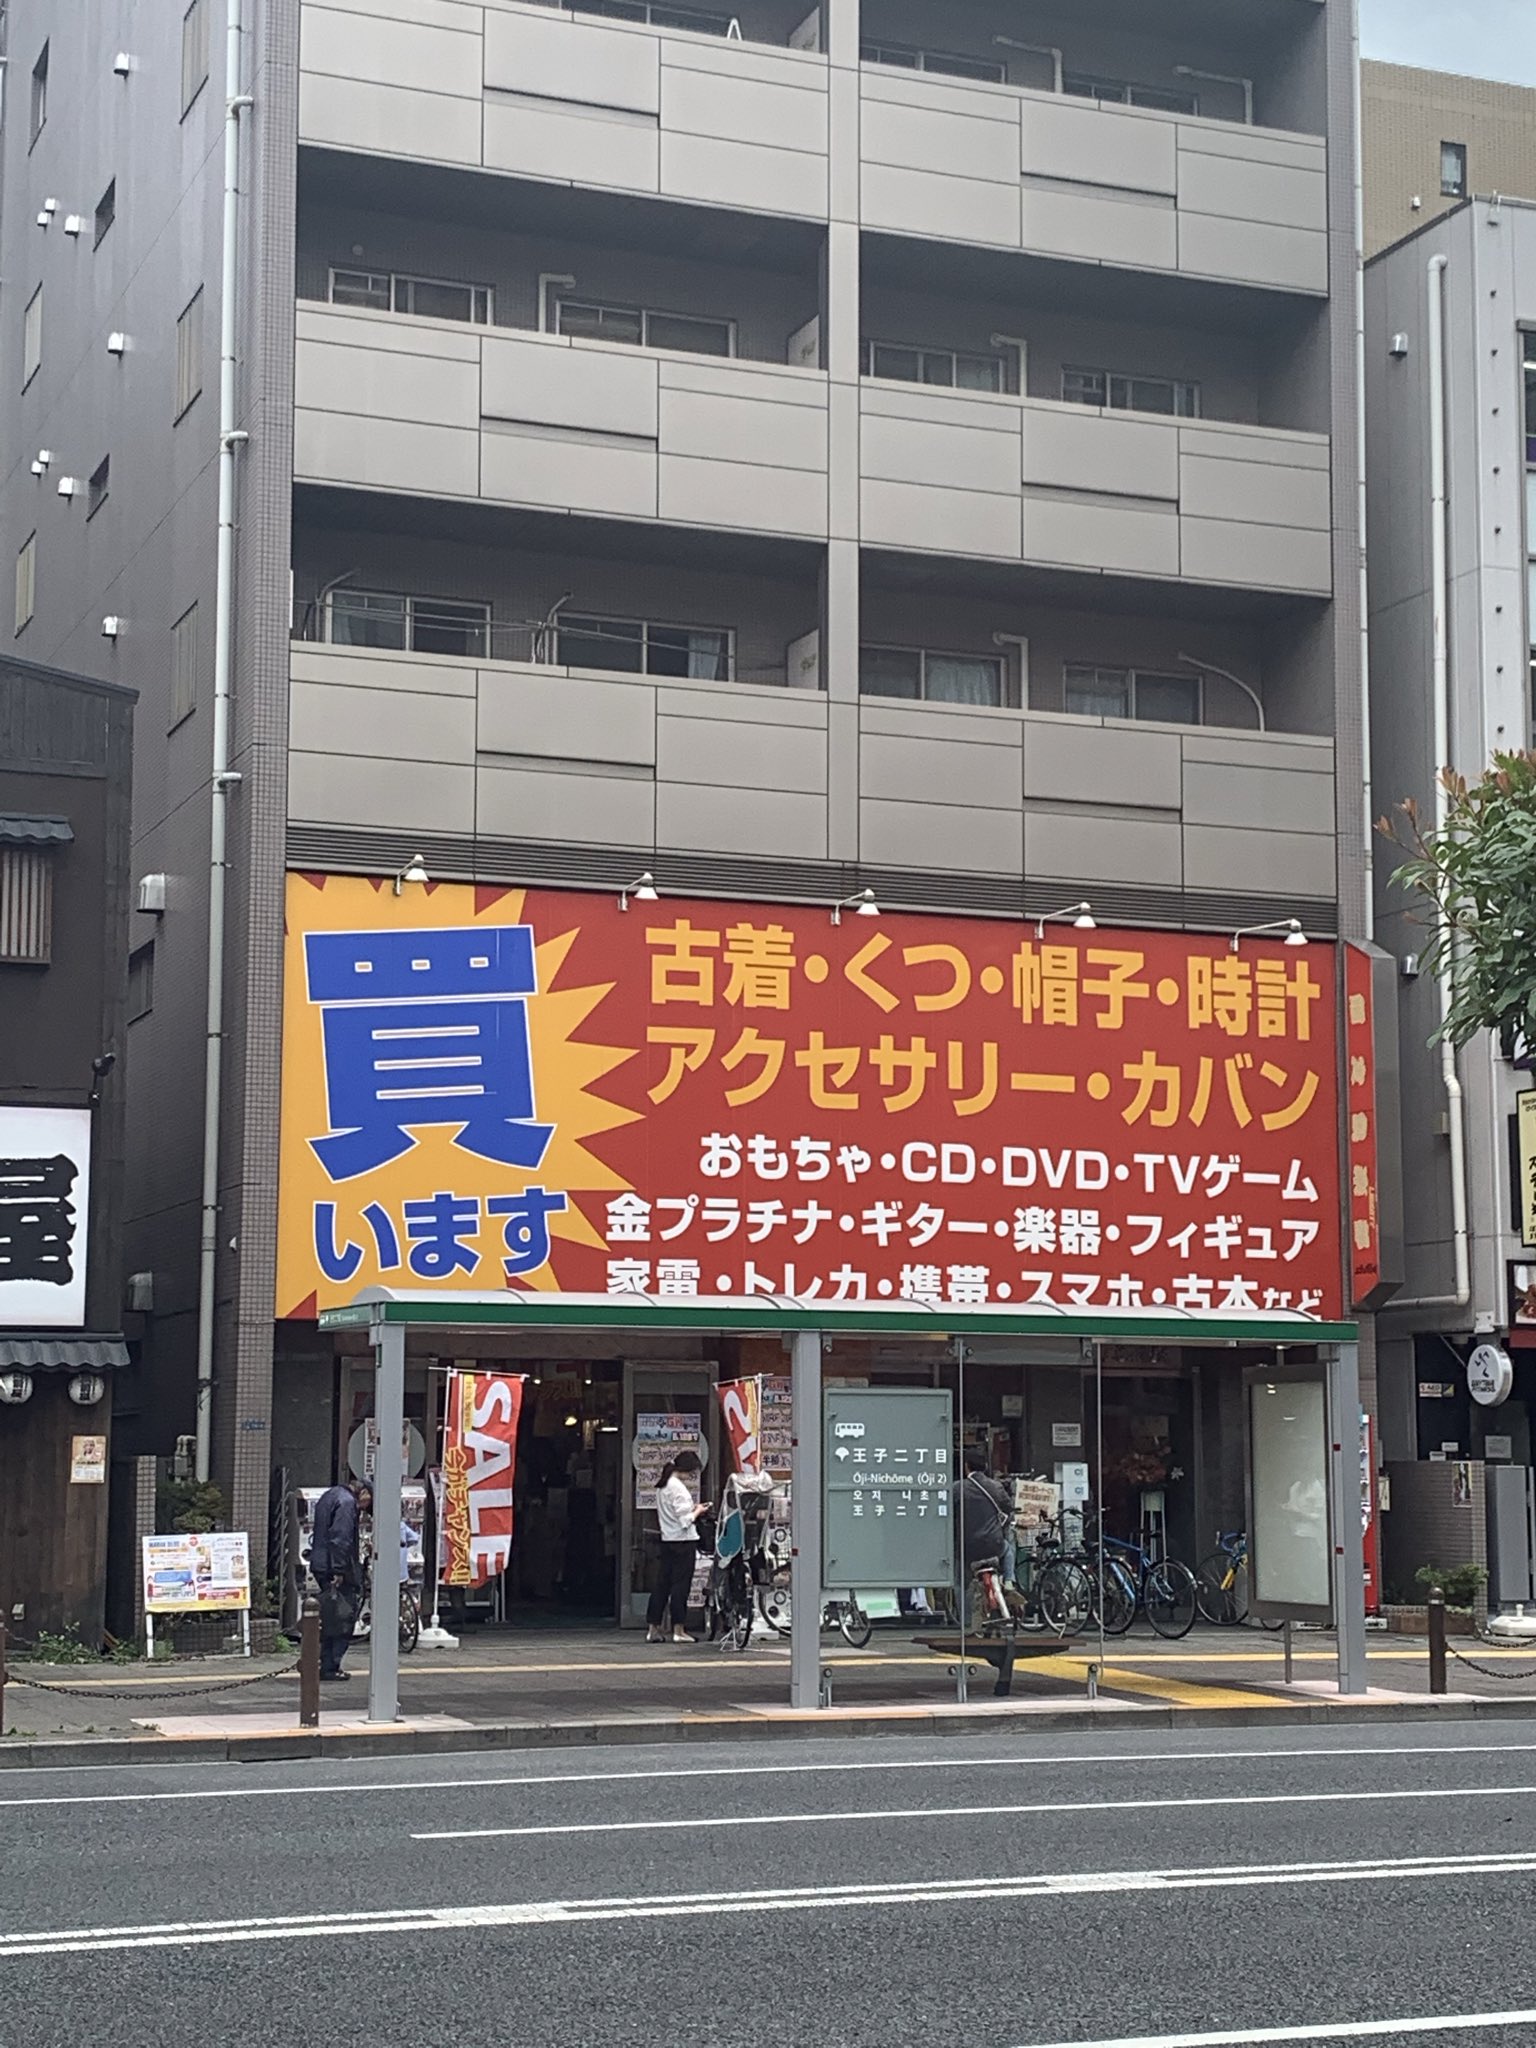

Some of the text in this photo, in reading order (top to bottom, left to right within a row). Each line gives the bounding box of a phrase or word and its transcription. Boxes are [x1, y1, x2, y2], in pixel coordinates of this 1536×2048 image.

[645, 919, 1320, 1041] 古着・くつ・帽子・時計
[302, 923, 558, 1184] 買
[646, 1025, 1319, 1132] アクセサリー・カバン
[699, 1132, 1319, 1203] おもちゃ・CD・DVD・TVゲーム
[311, 1184, 569, 1282] います
[605, 1191, 1320, 1263] 金プラチナ・ギター・楽器・フィギュア
[464, 1380, 513, 1580] SALE
[853, 1448, 947, 1463] 王子二丁目
